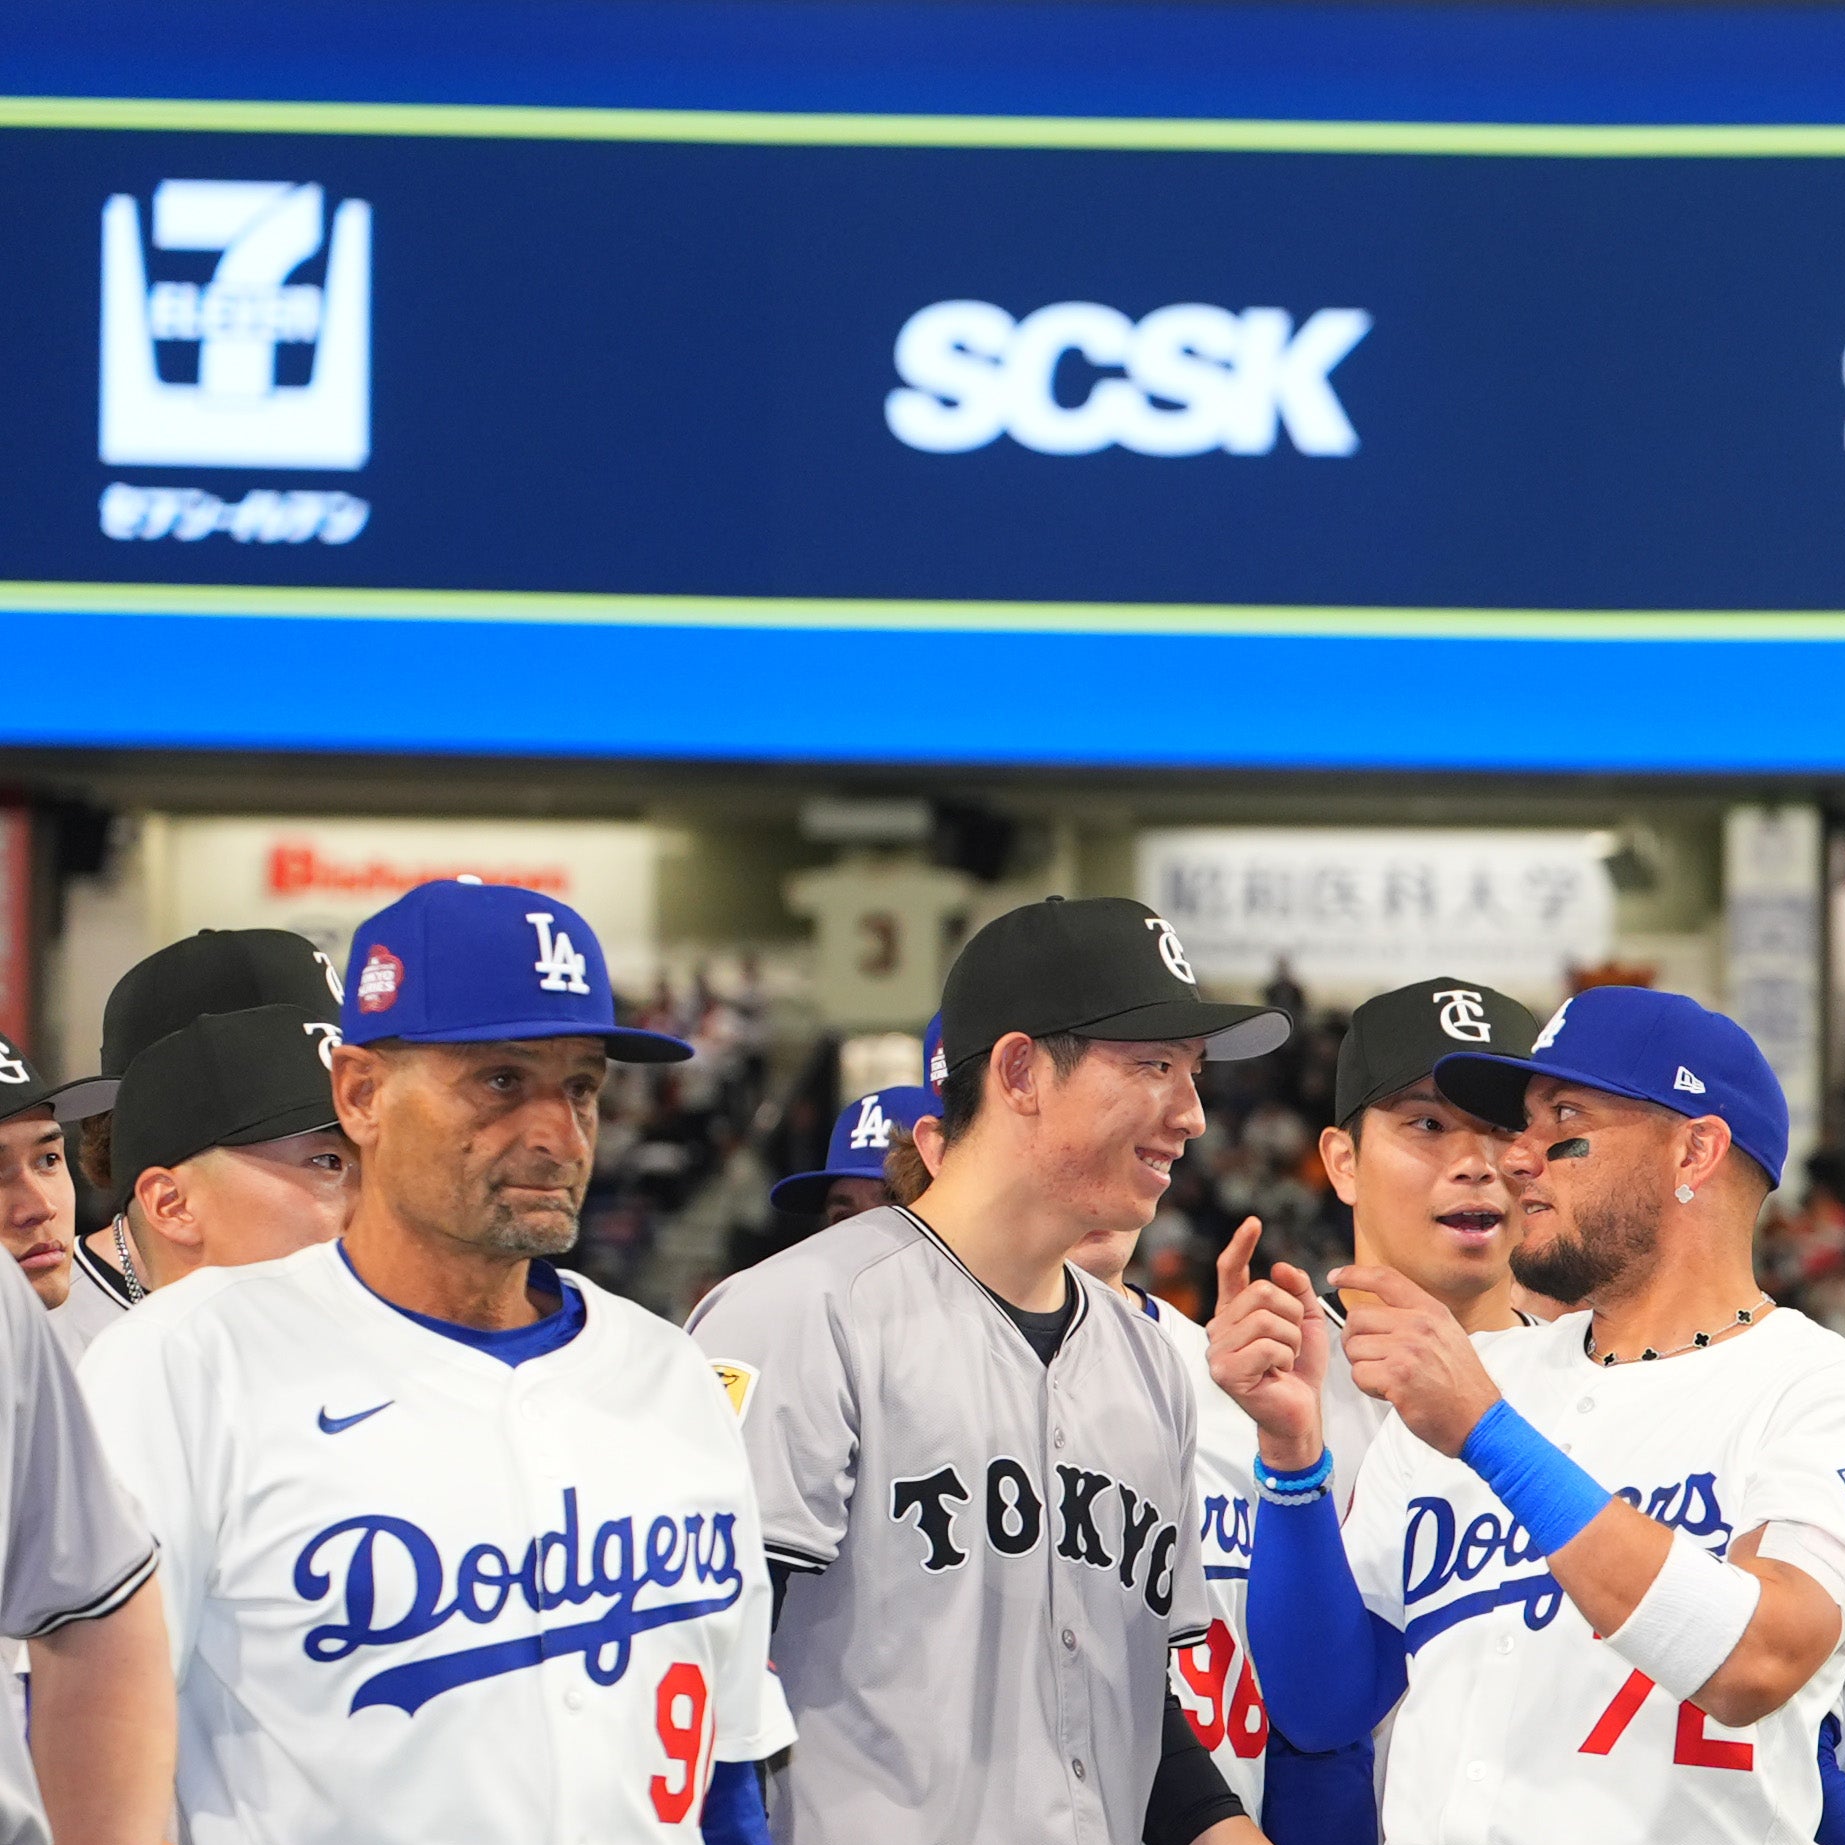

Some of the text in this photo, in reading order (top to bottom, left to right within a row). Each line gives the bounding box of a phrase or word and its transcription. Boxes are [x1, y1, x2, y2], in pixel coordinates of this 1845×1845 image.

[884, 299, 1374, 458] SCSK
[525, 912, 591, 995] LA
[851, 1094, 893, 1149] LA
[294, 1487, 744, 1687] Dodgers
[890, 1454, 1183, 1620] TOKYO
[649, 1662, 716, 1828] 9
